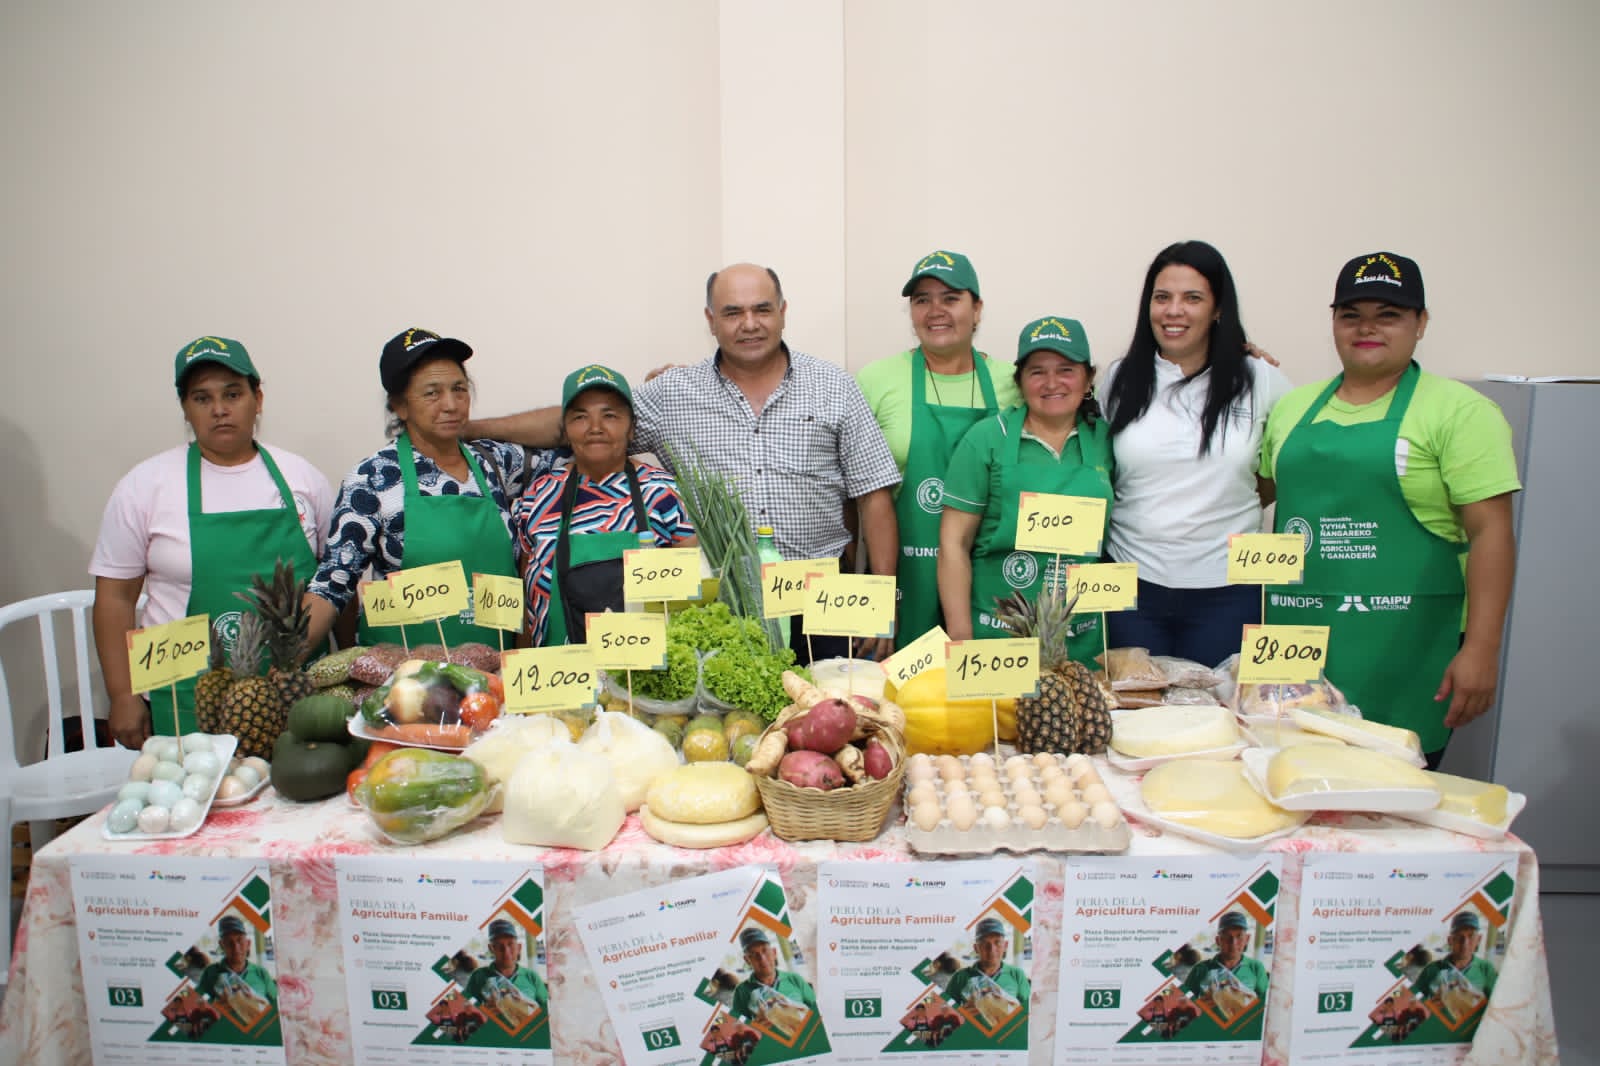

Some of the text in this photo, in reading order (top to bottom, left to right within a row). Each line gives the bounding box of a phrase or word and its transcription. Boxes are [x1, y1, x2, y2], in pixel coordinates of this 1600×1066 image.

[1027, 511, 1073, 532] 5.000
[1327, 551, 1377, 560] GANADERÍA
[632, 567, 683, 585] 5.000
[1071, 577, 1121, 595] 10.000
[480, 587, 520, 609] 10.000
[1279, 595, 1324, 609] UNOPS
[1370, 595, 1411, 605] ITAIPU
[601, 632, 651, 649] 5.000
[138, 639, 206, 671] 15.000
[956, 654, 1029, 681] 15.000
[872, 881, 890, 889] MAG
[1076, 896, 1146, 906] FERIA DE LA
[87, 905, 200, 918] Agricultura Familiar
[351, 907, 469, 922] Agricultura Familiar
[1075, 905, 1201, 917] Agricultura Familiar
[1312, 905, 1434, 919] Agricultura Familiar
[831, 914, 956, 926] Agricultura Familiar
[602, 930, 719, 964] Agricultura Familiar
[115, 989, 137, 1006] 03
[378, 991, 401, 1009] 03
[1090, 991, 1114, 1007] 03
[1324, 993, 1347, 1011] 03
[851, 999, 875, 1017] 03
[649, 1029, 674, 1047] 03
